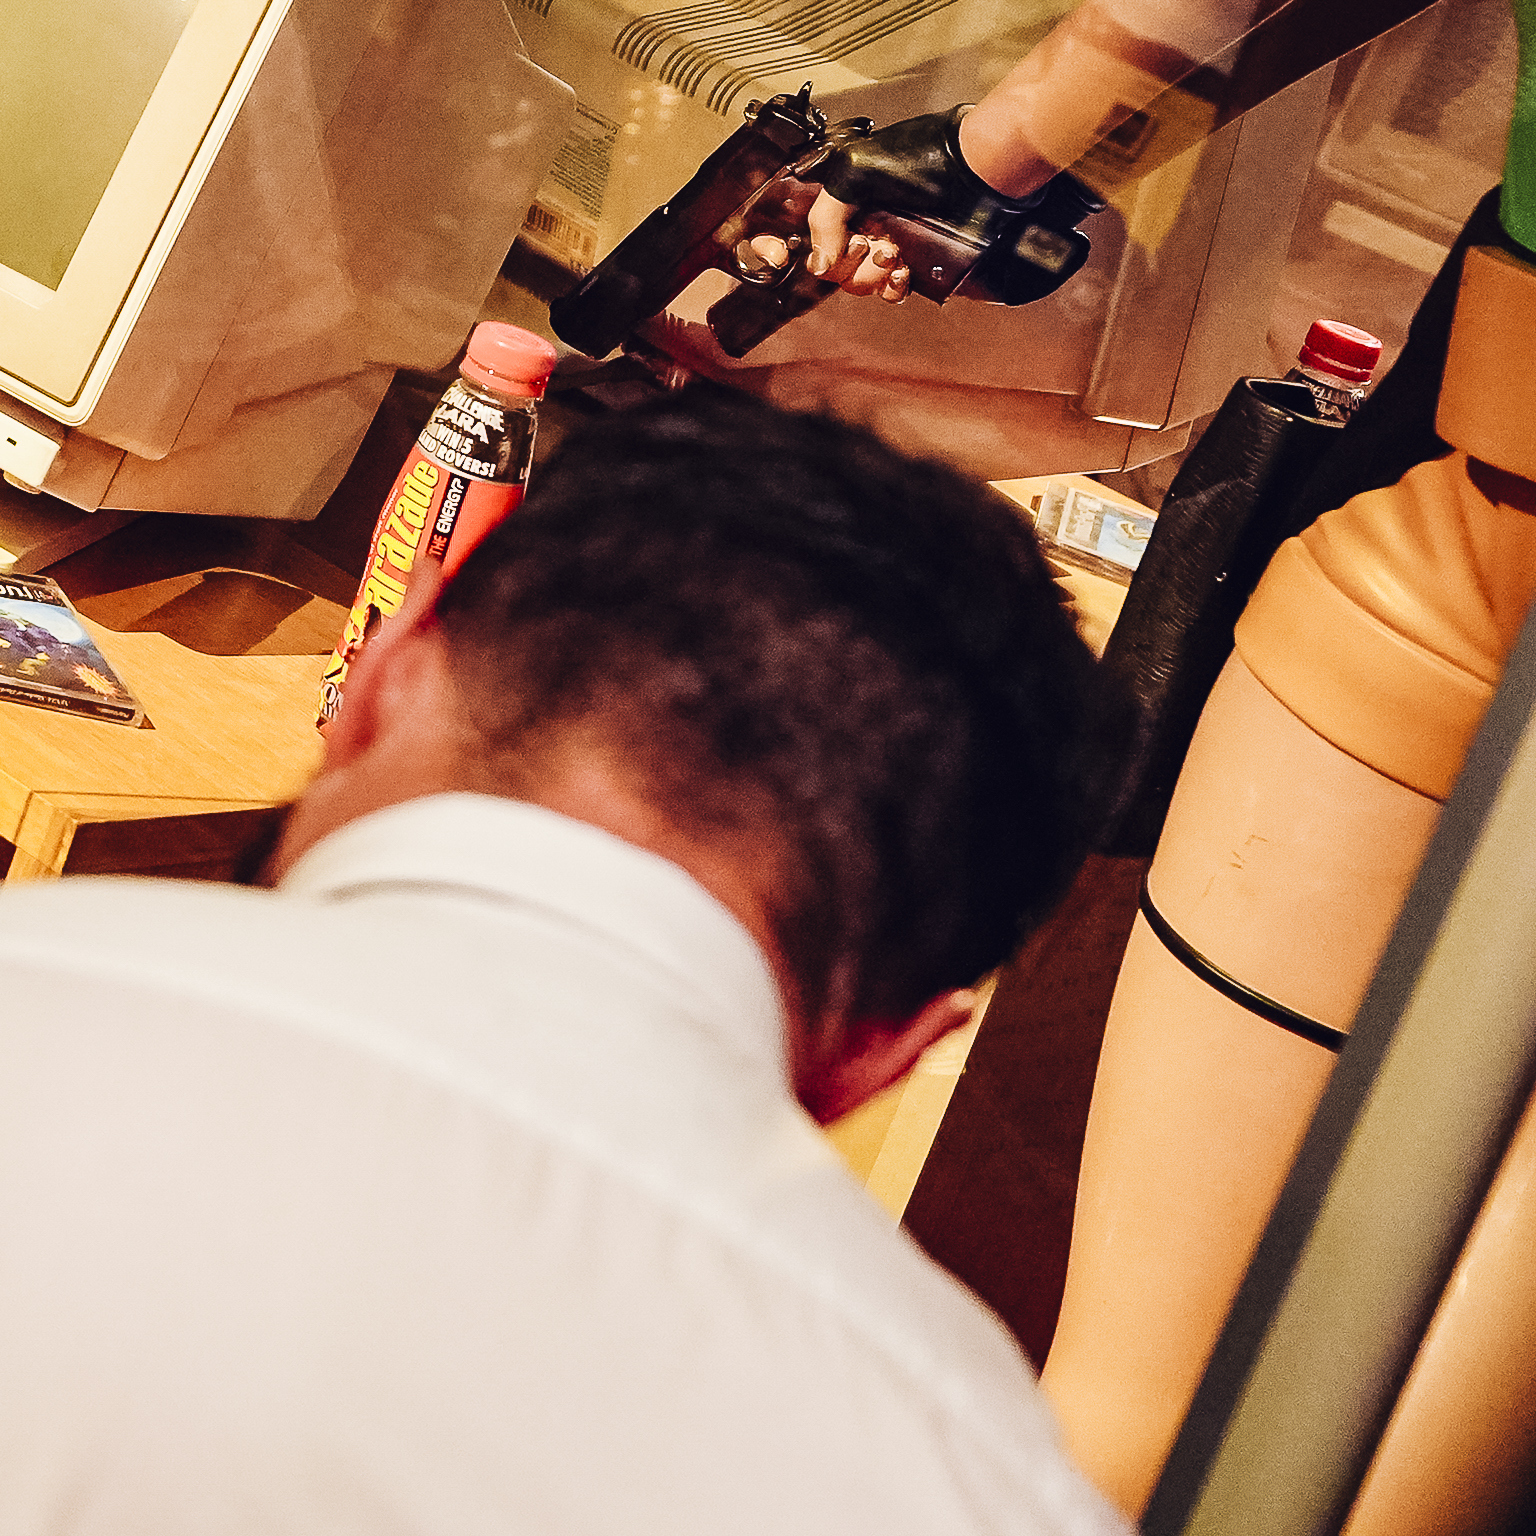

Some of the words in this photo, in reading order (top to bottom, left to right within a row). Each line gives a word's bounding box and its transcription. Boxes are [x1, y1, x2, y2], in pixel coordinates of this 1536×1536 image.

[435, 404, 489, 444] LARA
[435, 424, 462, 451] WIN
[461, 437, 474, 454] 5
[435, 445, 496, 477] ROVERS!
[430, 534, 447, 556] THE
